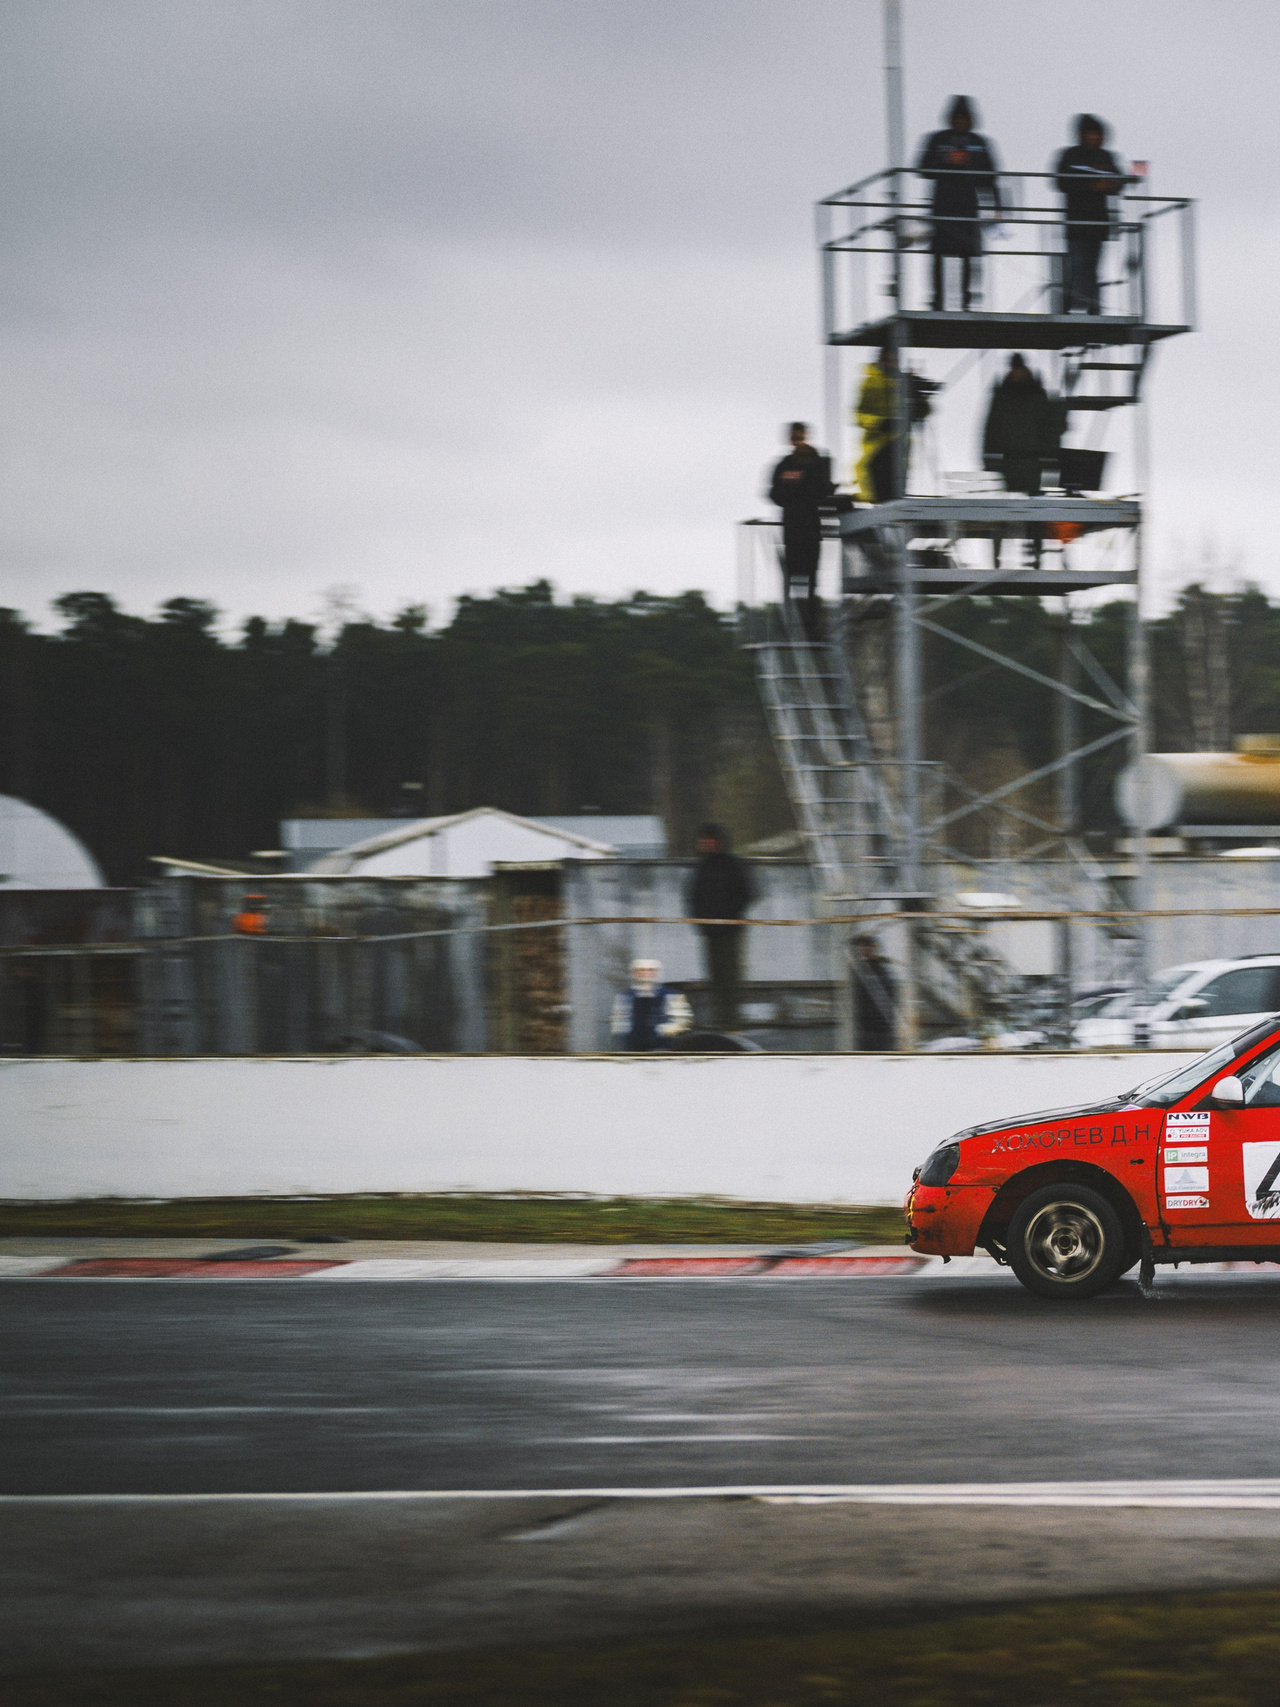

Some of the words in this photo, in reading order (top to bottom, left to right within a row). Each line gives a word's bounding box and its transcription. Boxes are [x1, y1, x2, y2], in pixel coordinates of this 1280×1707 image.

[991, 1127, 1103, 1154] ХОХОРЕВ
[1111, 1124, 1157, 1147] Д.Н.
[1181, 1151, 1206, 1159] integra
